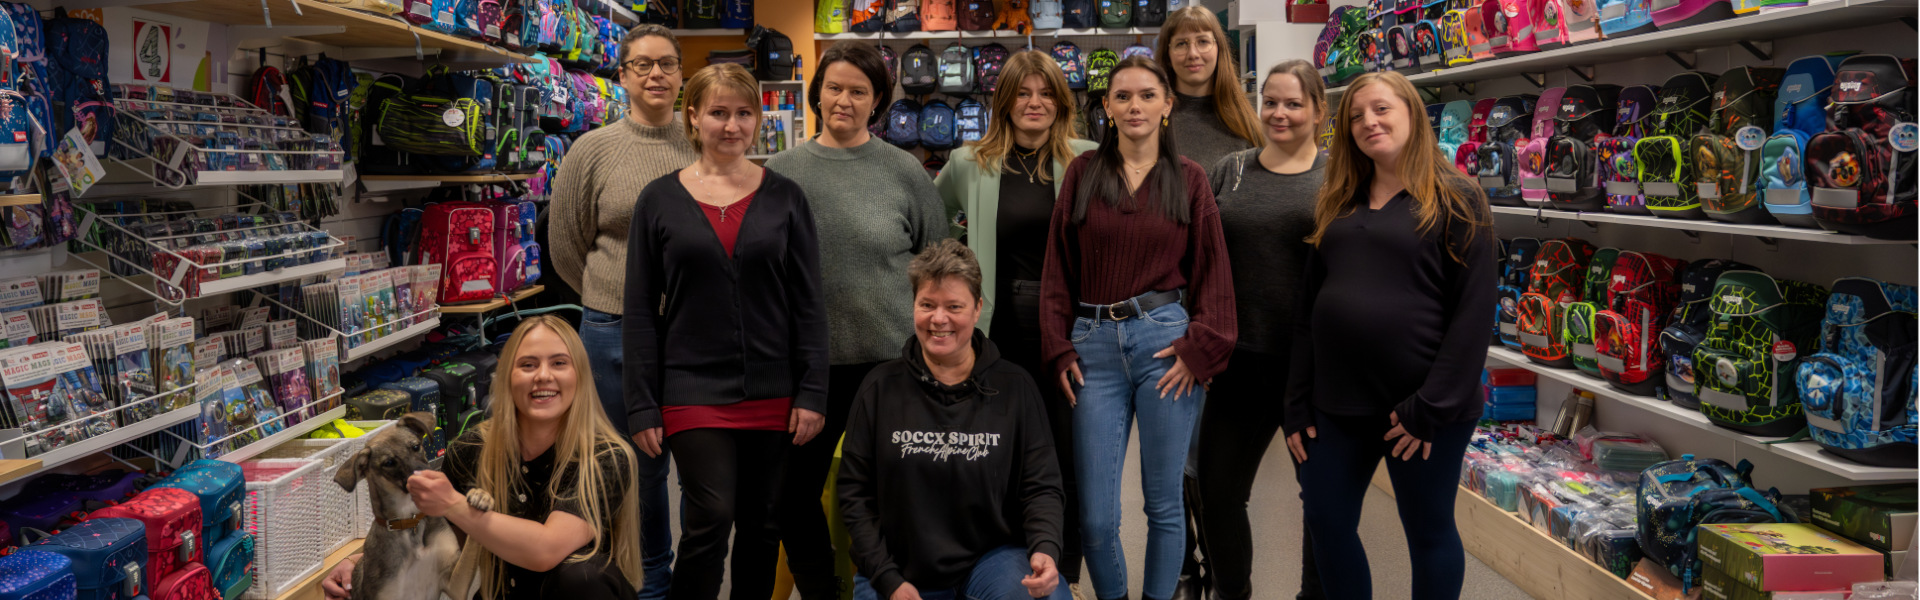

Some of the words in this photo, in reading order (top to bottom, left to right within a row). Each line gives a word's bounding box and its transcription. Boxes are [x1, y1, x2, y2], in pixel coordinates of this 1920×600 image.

[139, 25, 161, 77] 4
[20, 288, 38, 297] MAGS
[60, 312, 78, 321] MAGIC
[79, 311, 97, 319] MAGS
[9, 322, 30, 332] MAGS
[66, 352, 85, 362] MAGS
[3, 364, 29, 376] MAGIC
[30, 359, 51, 370] MAGS
[892, 430, 945, 445] SOCCX
[948, 431, 1000, 446] SPIRIT
[966, 441, 989, 461] Club
